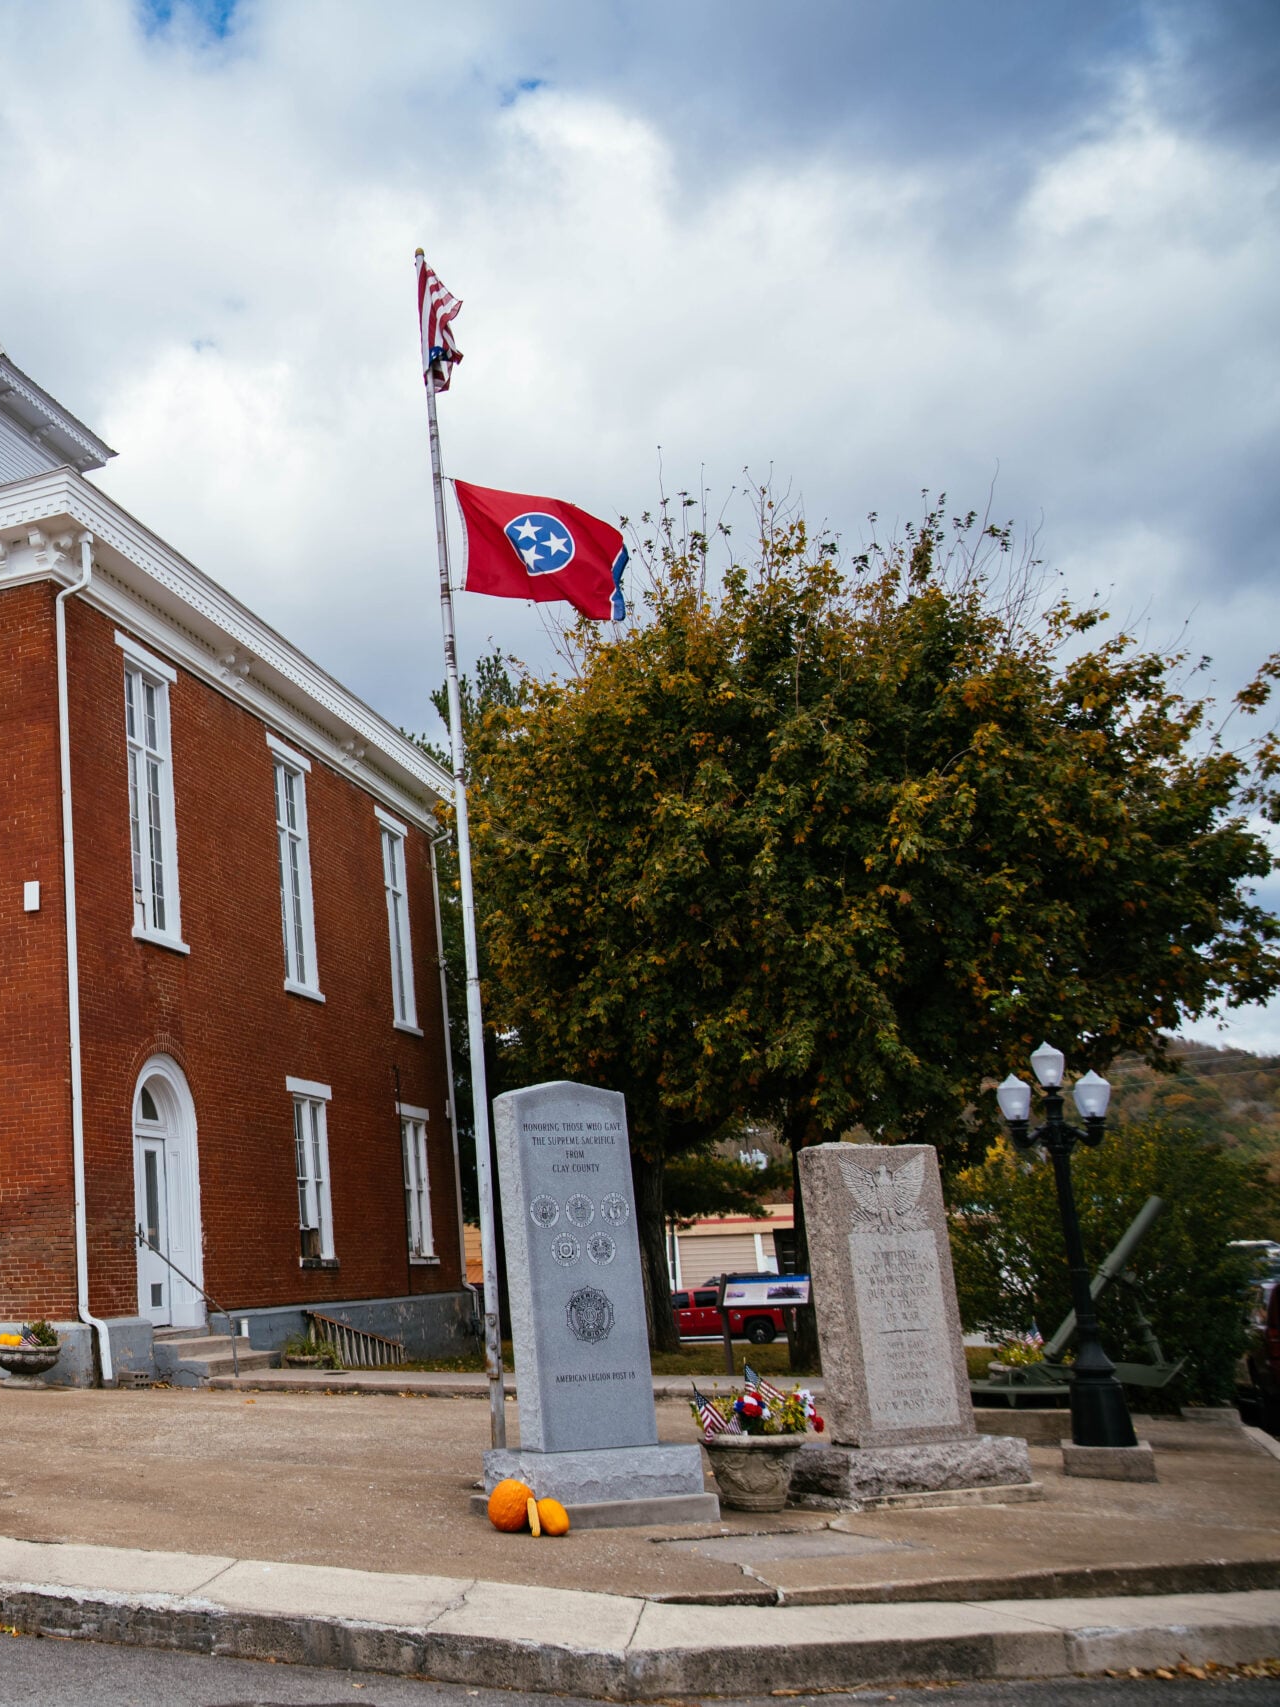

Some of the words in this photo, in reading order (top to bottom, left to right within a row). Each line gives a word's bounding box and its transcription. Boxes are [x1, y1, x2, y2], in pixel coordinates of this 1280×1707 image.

[523, 1122, 560, 1133] HONORING
[562, 1122, 585, 1131] THOSE
[586, 1122, 603, 1131] WHO
[604, 1122, 622, 1131] GAVE
[532, 1136, 546, 1146] THE
[547, 1136, 580, 1146] SUPREME
[581, 1135, 616, 1145] SACRIFICE
[565, 1150, 585, 1159] FROM
[552, 1163, 570, 1173] CLAY
[572, 1163, 600, 1173] COUNTY
[569, 1293, 607, 1310] AMERICAN
[556, 1374, 587, 1384] AMERICAN
[588, 1372, 611, 1382] LEGION
[612, 1371, 627, 1381] POST
